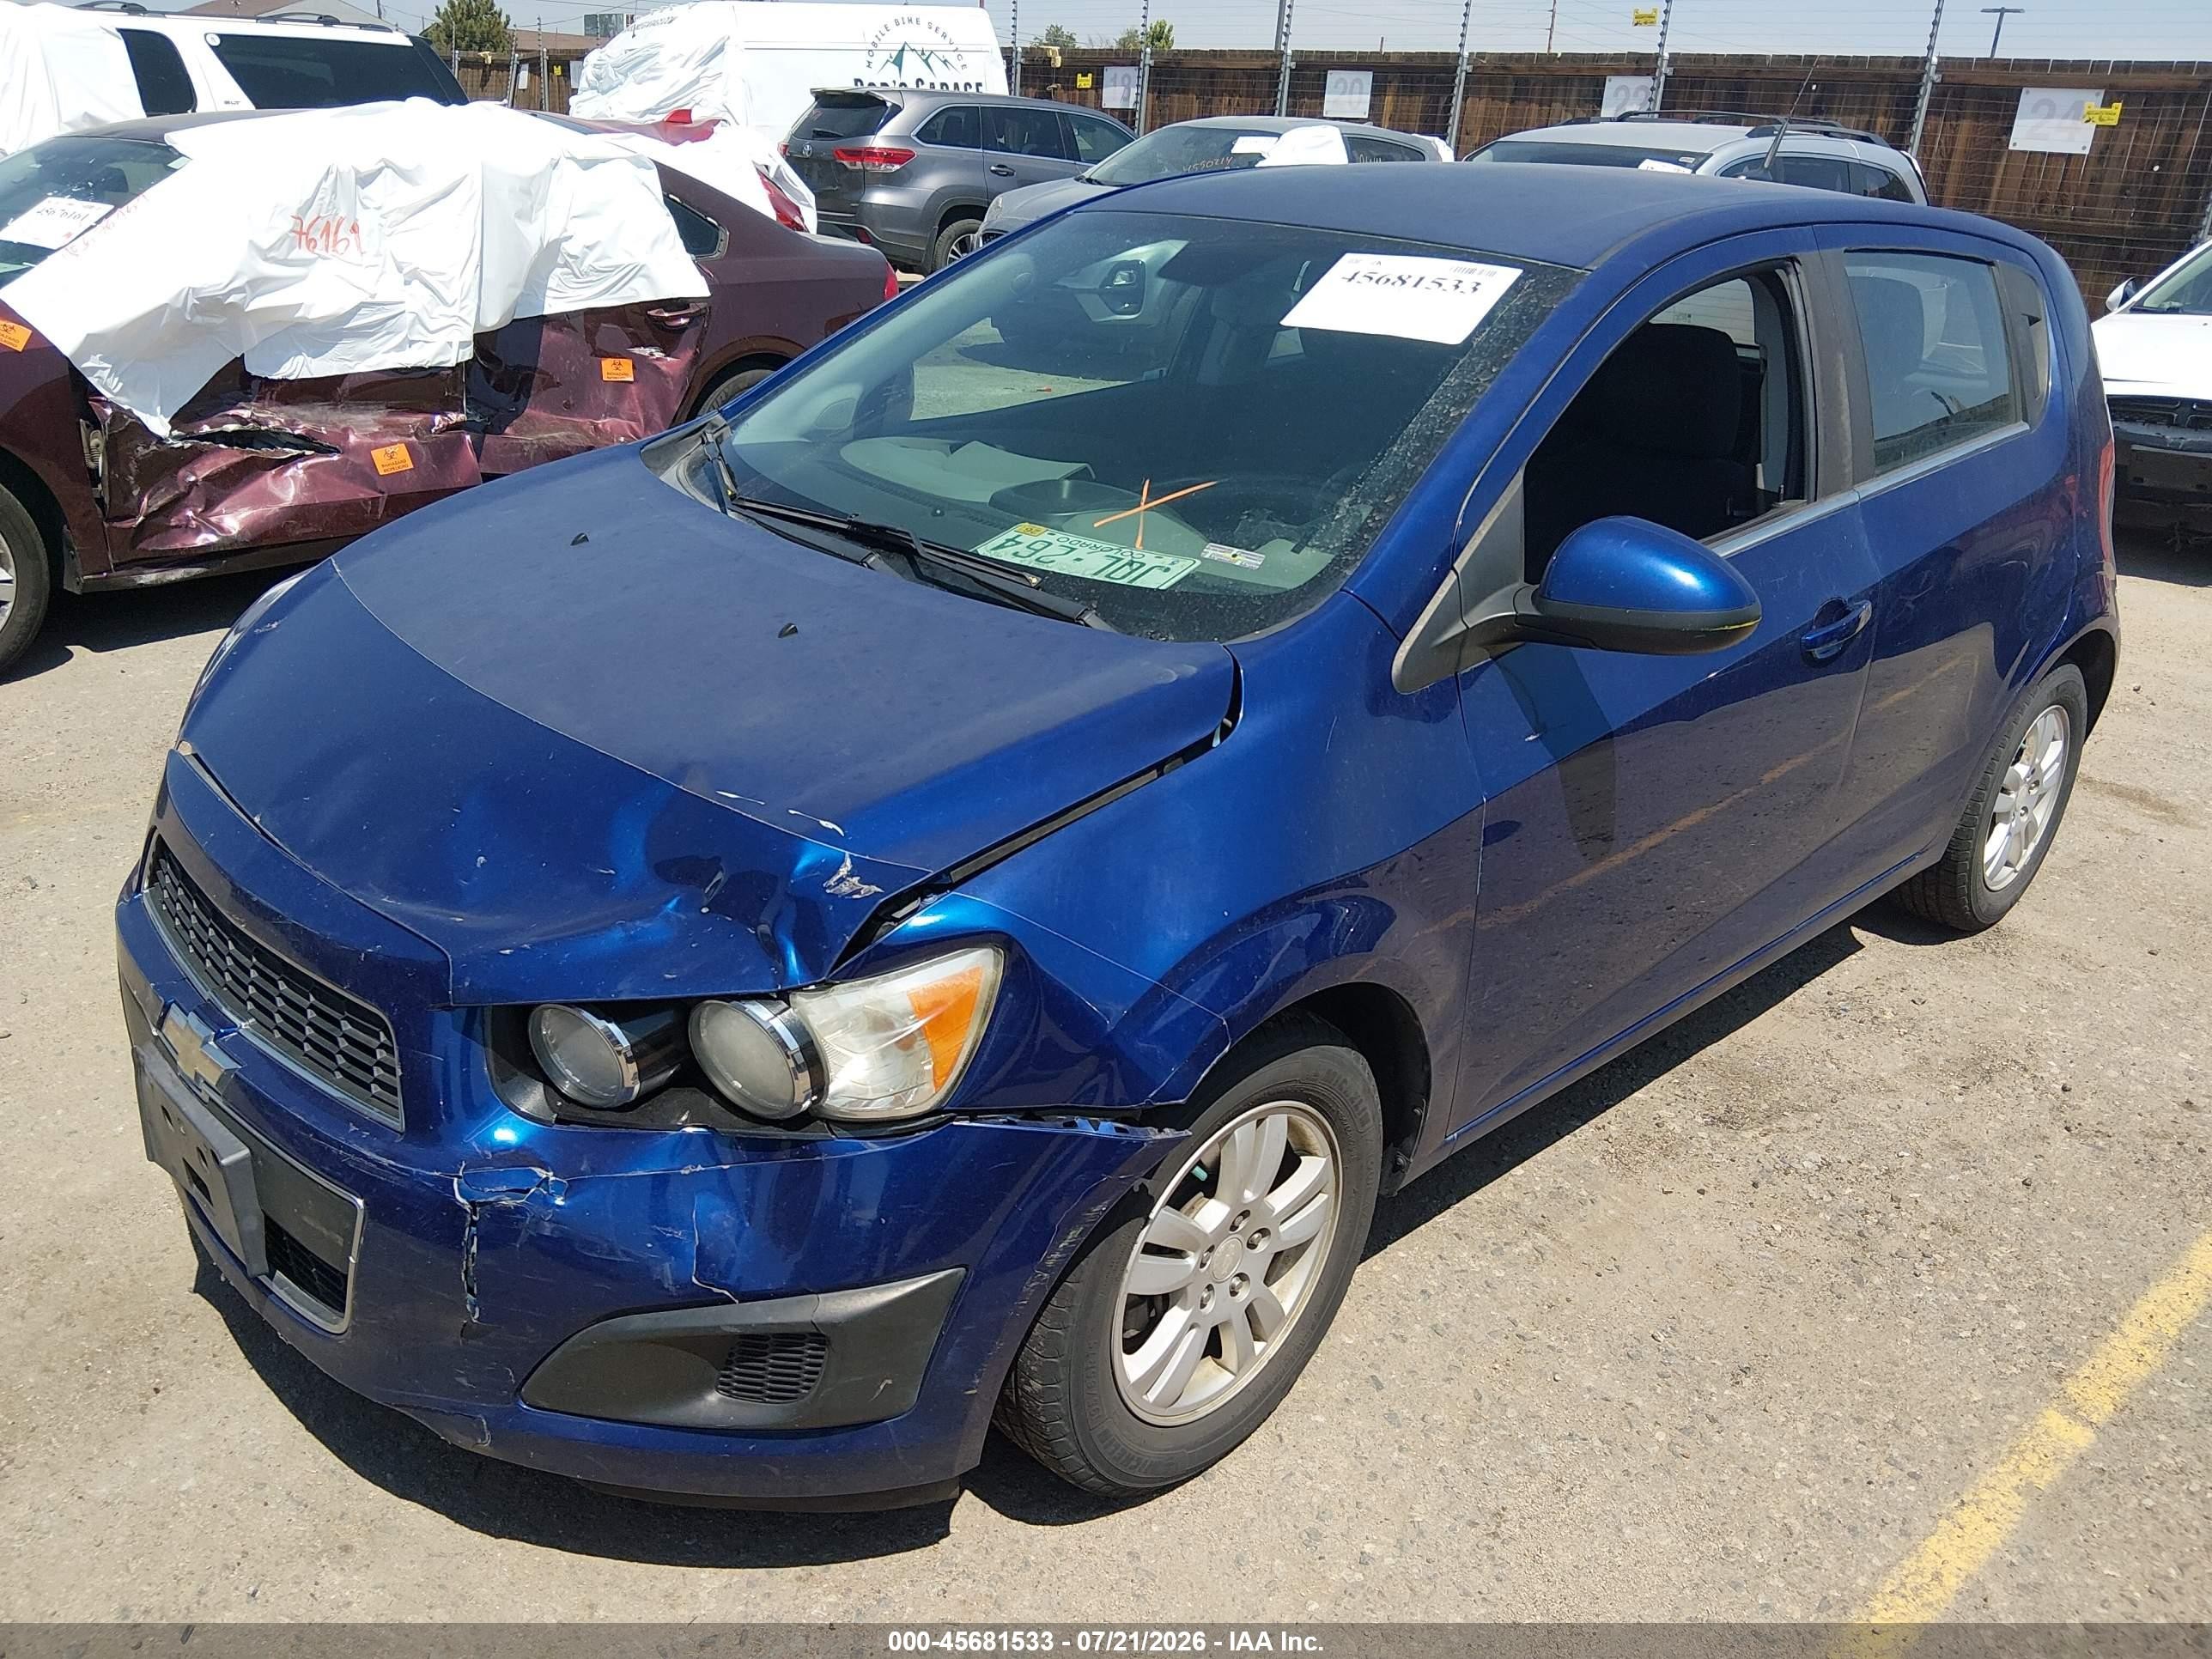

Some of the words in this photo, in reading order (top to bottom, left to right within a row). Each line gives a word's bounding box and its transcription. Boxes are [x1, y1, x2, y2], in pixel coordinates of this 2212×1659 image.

[866, 24, 890, 69] MOBILE
[894, 16, 921, 27] BIKE
[927, 21, 968, 70] SERVICE
[1333, 76, 1364, 111] 20
[2024, 97, 2085, 142] 24
[1341, 270, 1482, 294] 45681533
[1055, 536, 1146, 560] COLORADO
